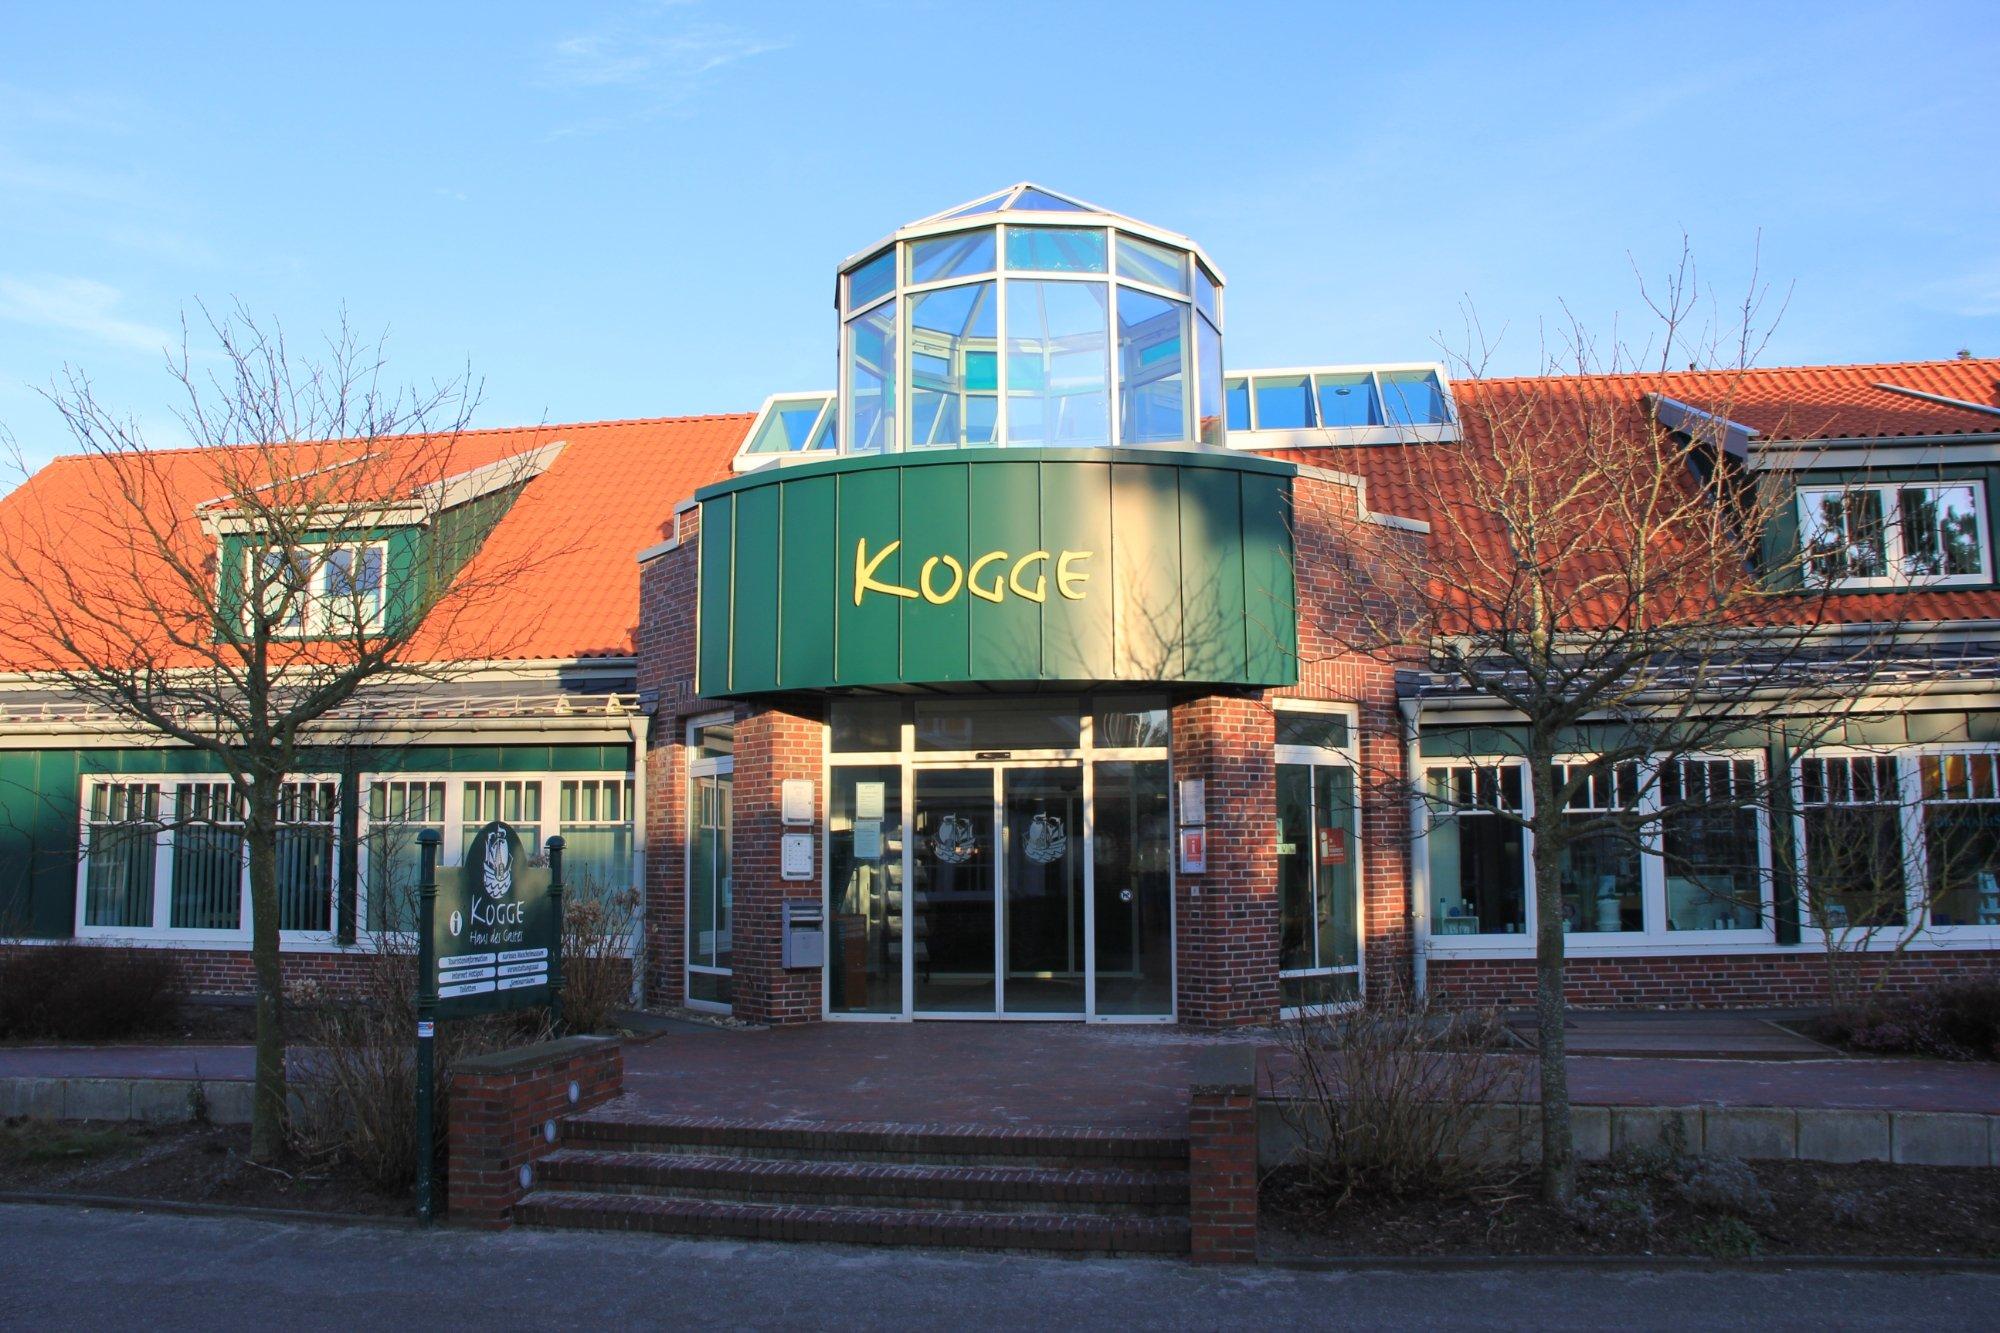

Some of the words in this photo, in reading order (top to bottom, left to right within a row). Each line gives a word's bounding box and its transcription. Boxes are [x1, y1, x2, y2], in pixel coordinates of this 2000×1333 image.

[854, 537, 1094, 607] KOGGE
[470, 894, 525, 926] KOGGE
[470, 930, 488, 945] Haus
[490, 928, 502, 943] des
[503, 928, 524, 943] Gastes
